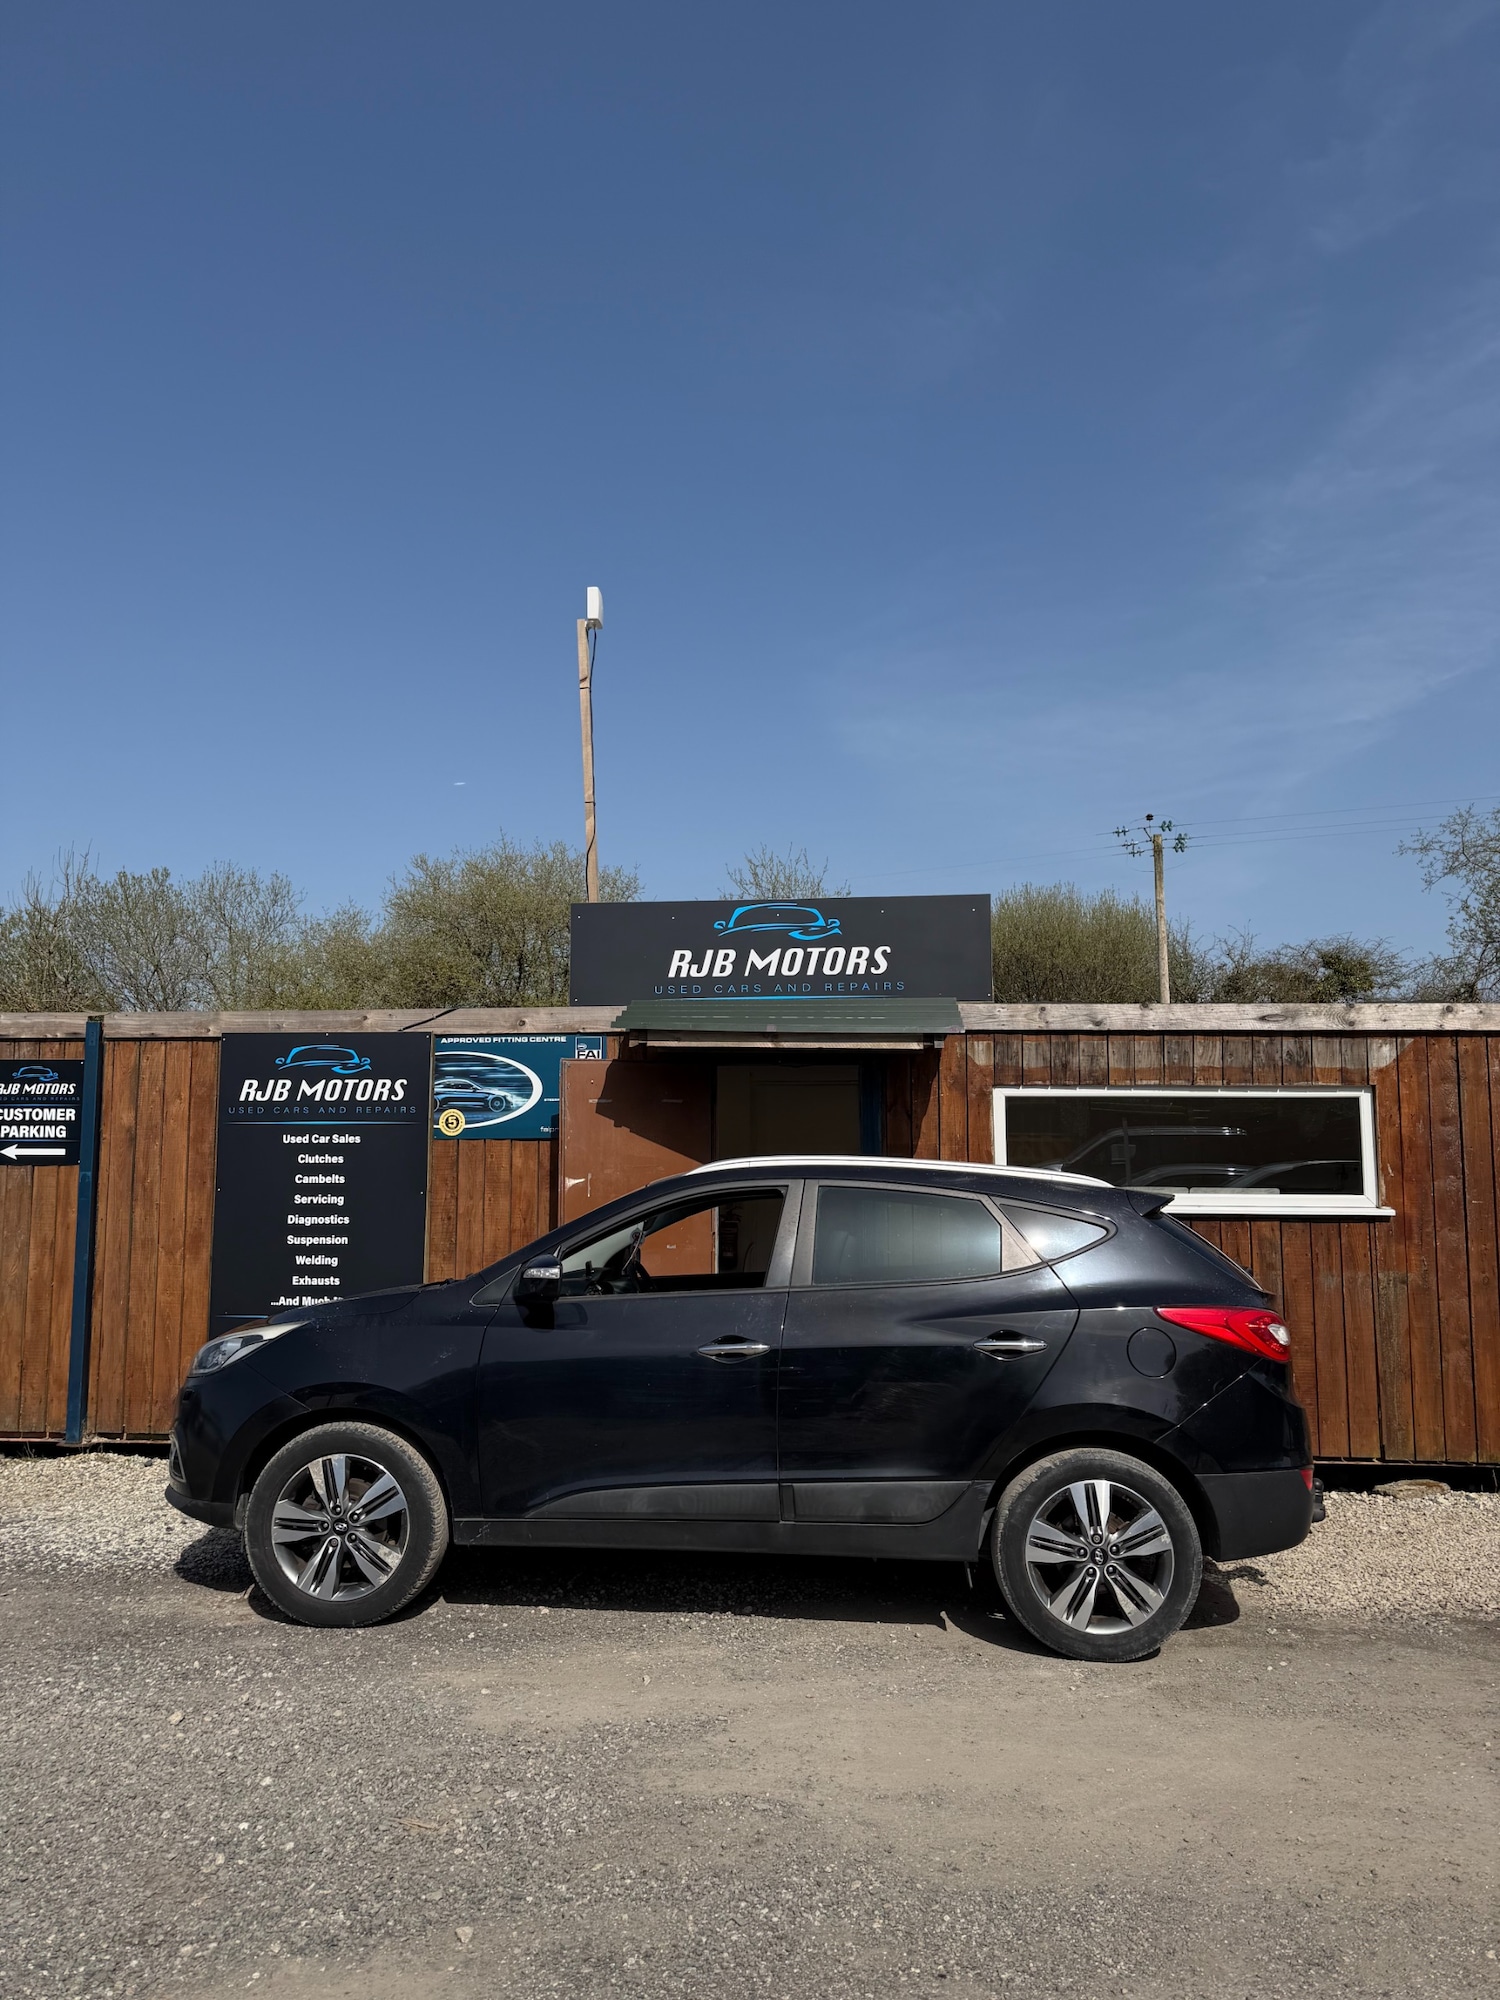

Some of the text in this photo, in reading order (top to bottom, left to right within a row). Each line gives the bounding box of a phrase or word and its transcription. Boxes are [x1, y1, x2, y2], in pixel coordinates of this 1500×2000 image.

[668, 946, 891, 977] RJB MOTORS
[654, 981, 905, 995] USED CARS AND REPAIRS
[577, 1050, 600, 1059] FAI
[22, 1083, 76, 1094] MOTORS
[239, 1079, 407, 1101] RJB MOTORS
[228, 1107, 265, 1115] USED
[1, 1125, 66, 1138] PARKING
[283, 1134, 360, 1143] Used Car Sales
[298, 1154, 343, 1163] Clutches
[295, 1174, 345, 1183] Cambelts
[294, 1194, 344, 1206] Servicing
[288, 1215, 349, 1226] Diagnostics
[287, 1235, 348, 1246] Suspension
[296, 1255, 338, 1267] Welding
[293, 1276, 340, 1285] Exhausts
